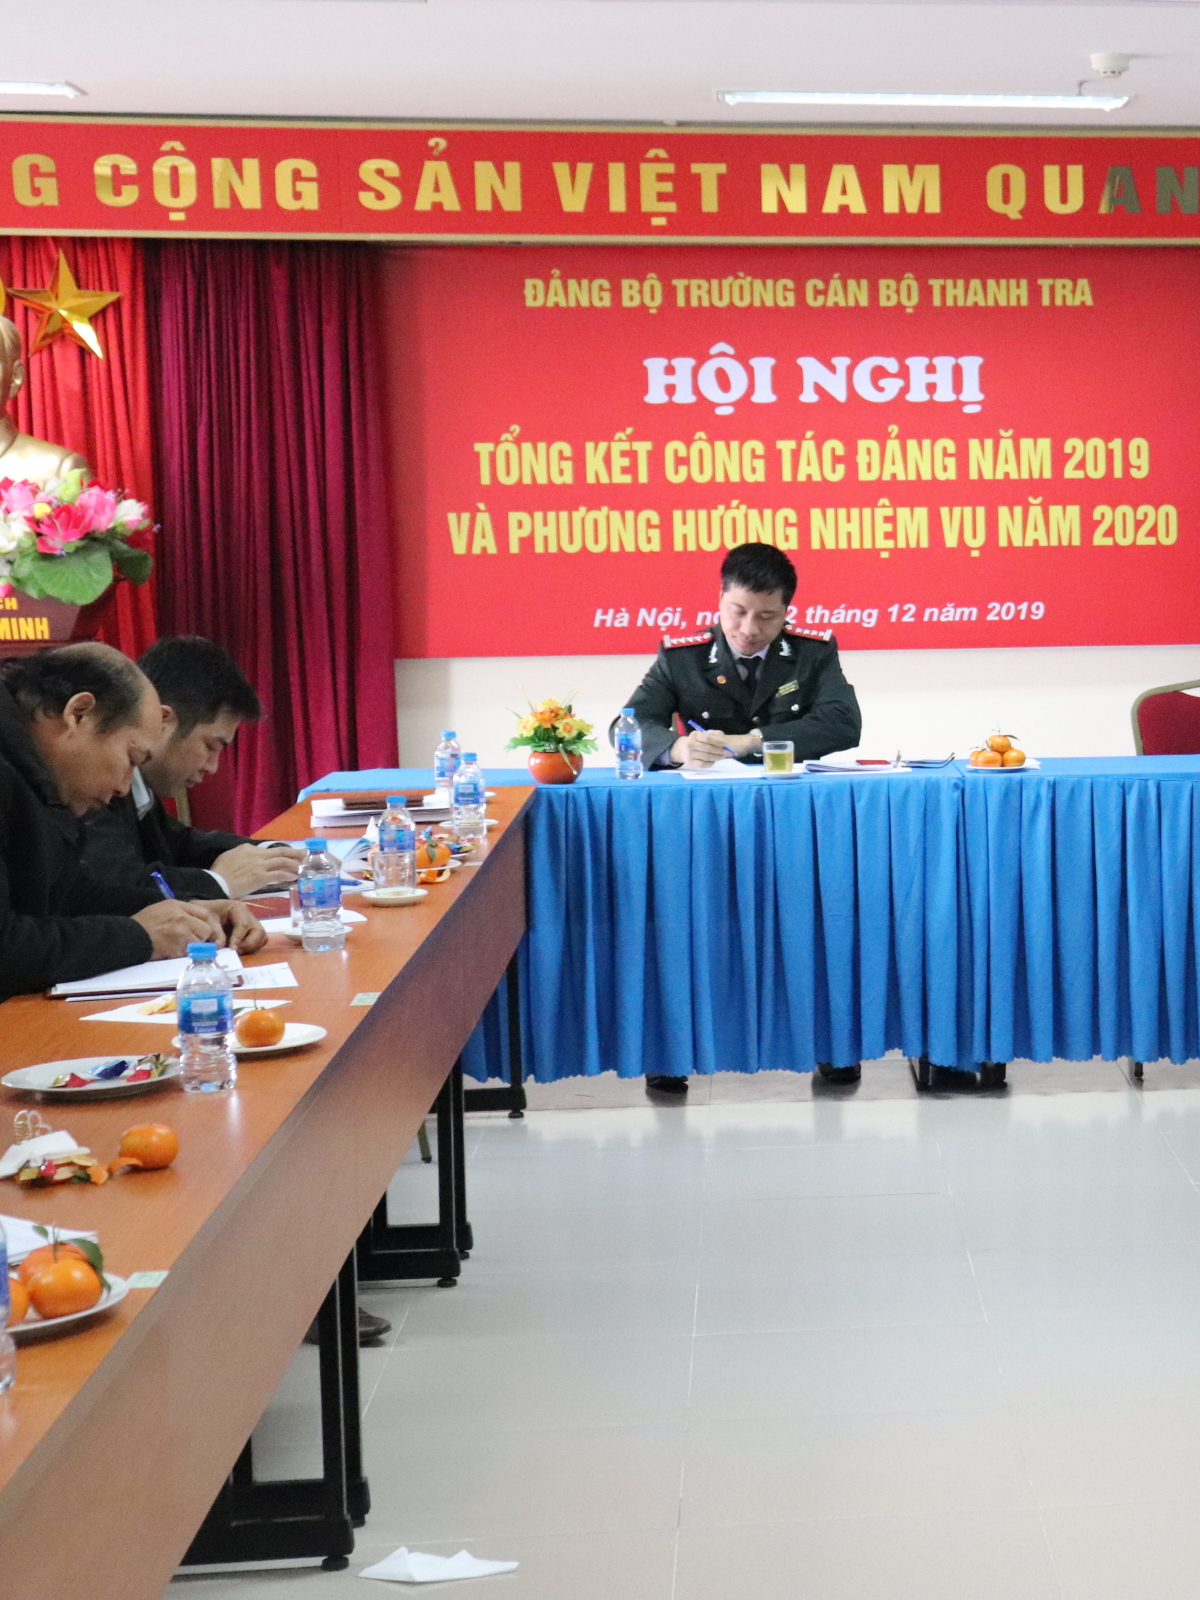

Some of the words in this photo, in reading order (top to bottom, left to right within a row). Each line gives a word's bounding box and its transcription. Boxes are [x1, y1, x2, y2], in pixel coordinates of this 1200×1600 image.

[93, 140, 321, 222] CỘNG
[357, 136, 523, 214] SẢN
[551, 147, 728, 227] VIỆT
[760, 162, 943, 215] NAM
[523, 267, 612, 308] ĐẢNG
[621, 273, 663, 314] BỘ
[671, 271, 796, 308] TRƯỜNG
[805, 273, 870, 308] CÁN
[878, 275, 920, 314] BỘ
[928, 278, 1029, 308] THANH
[1038, 278, 1094, 307] TRA
[643, 341, 778, 416] HỘI
[797, 355, 985, 414] NGHỊ
[474, 424, 573, 486] TỔNG
[585, 427, 653, 485] KẾT
[664, 432, 766, 484] CÔNG
[776, 431, 846, 483] TÁC
[856, 424, 958, 482] ĐẢNG
[968, 428, 1053, 481] NĂM
[1063, 437, 1150, 480] 2019
[447, 502, 498, 555] VÀ
[508, 505, 661, 554] PHƯƠNG
[672, 499, 799, 552] HƯỚNG
[809, 497, 930, 560] NHIỆM
[940, 505, 987, 558] VỤ
[997, 495, 1081, 548] NĂM
[1092, 504, 1178, 547] 2020
[593, 607, 630, 628] Hà
[636, 606, 687, 631] Nội,
[805, 603, 878, 628] tháng
[888, 604, 917, 623] 12
[923, 602, 978, 622] năm
[985, 601, 1045, 621] 2019
